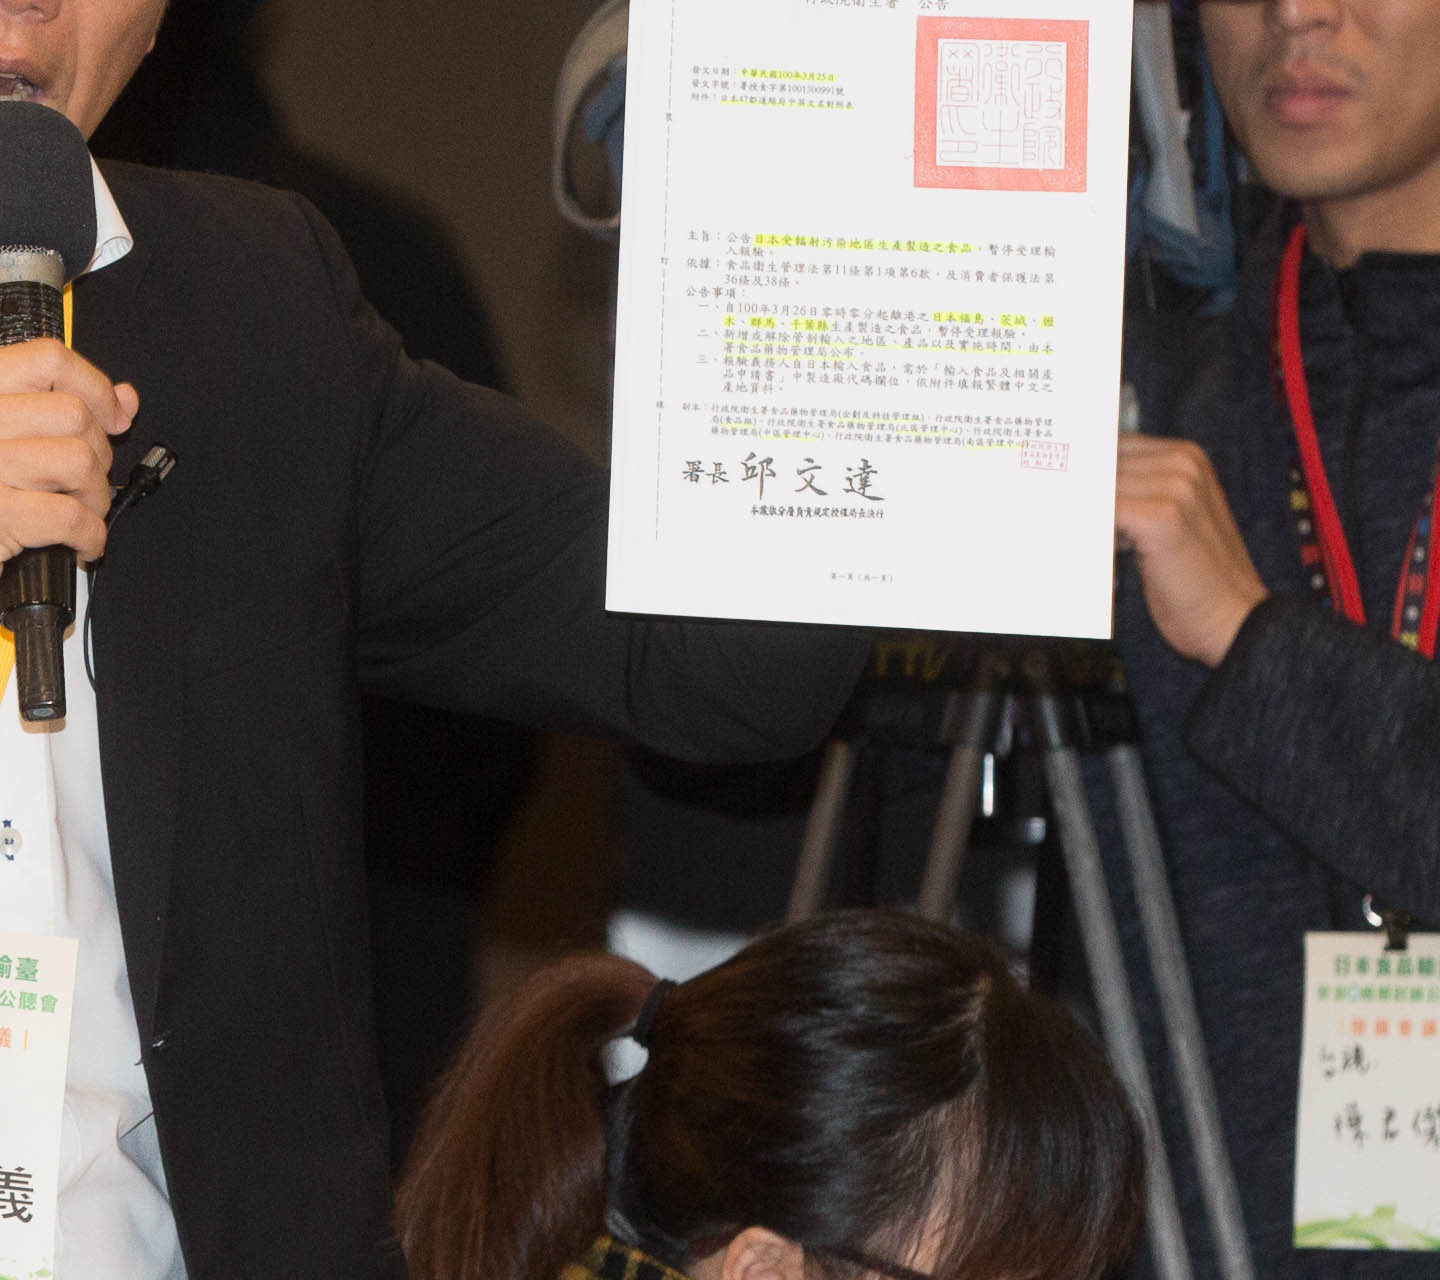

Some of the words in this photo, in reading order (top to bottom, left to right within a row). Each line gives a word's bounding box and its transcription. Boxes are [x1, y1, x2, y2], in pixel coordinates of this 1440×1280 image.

[682, 460, 730, 485] 署長
[740, 451, 885, 501] 邱文達
